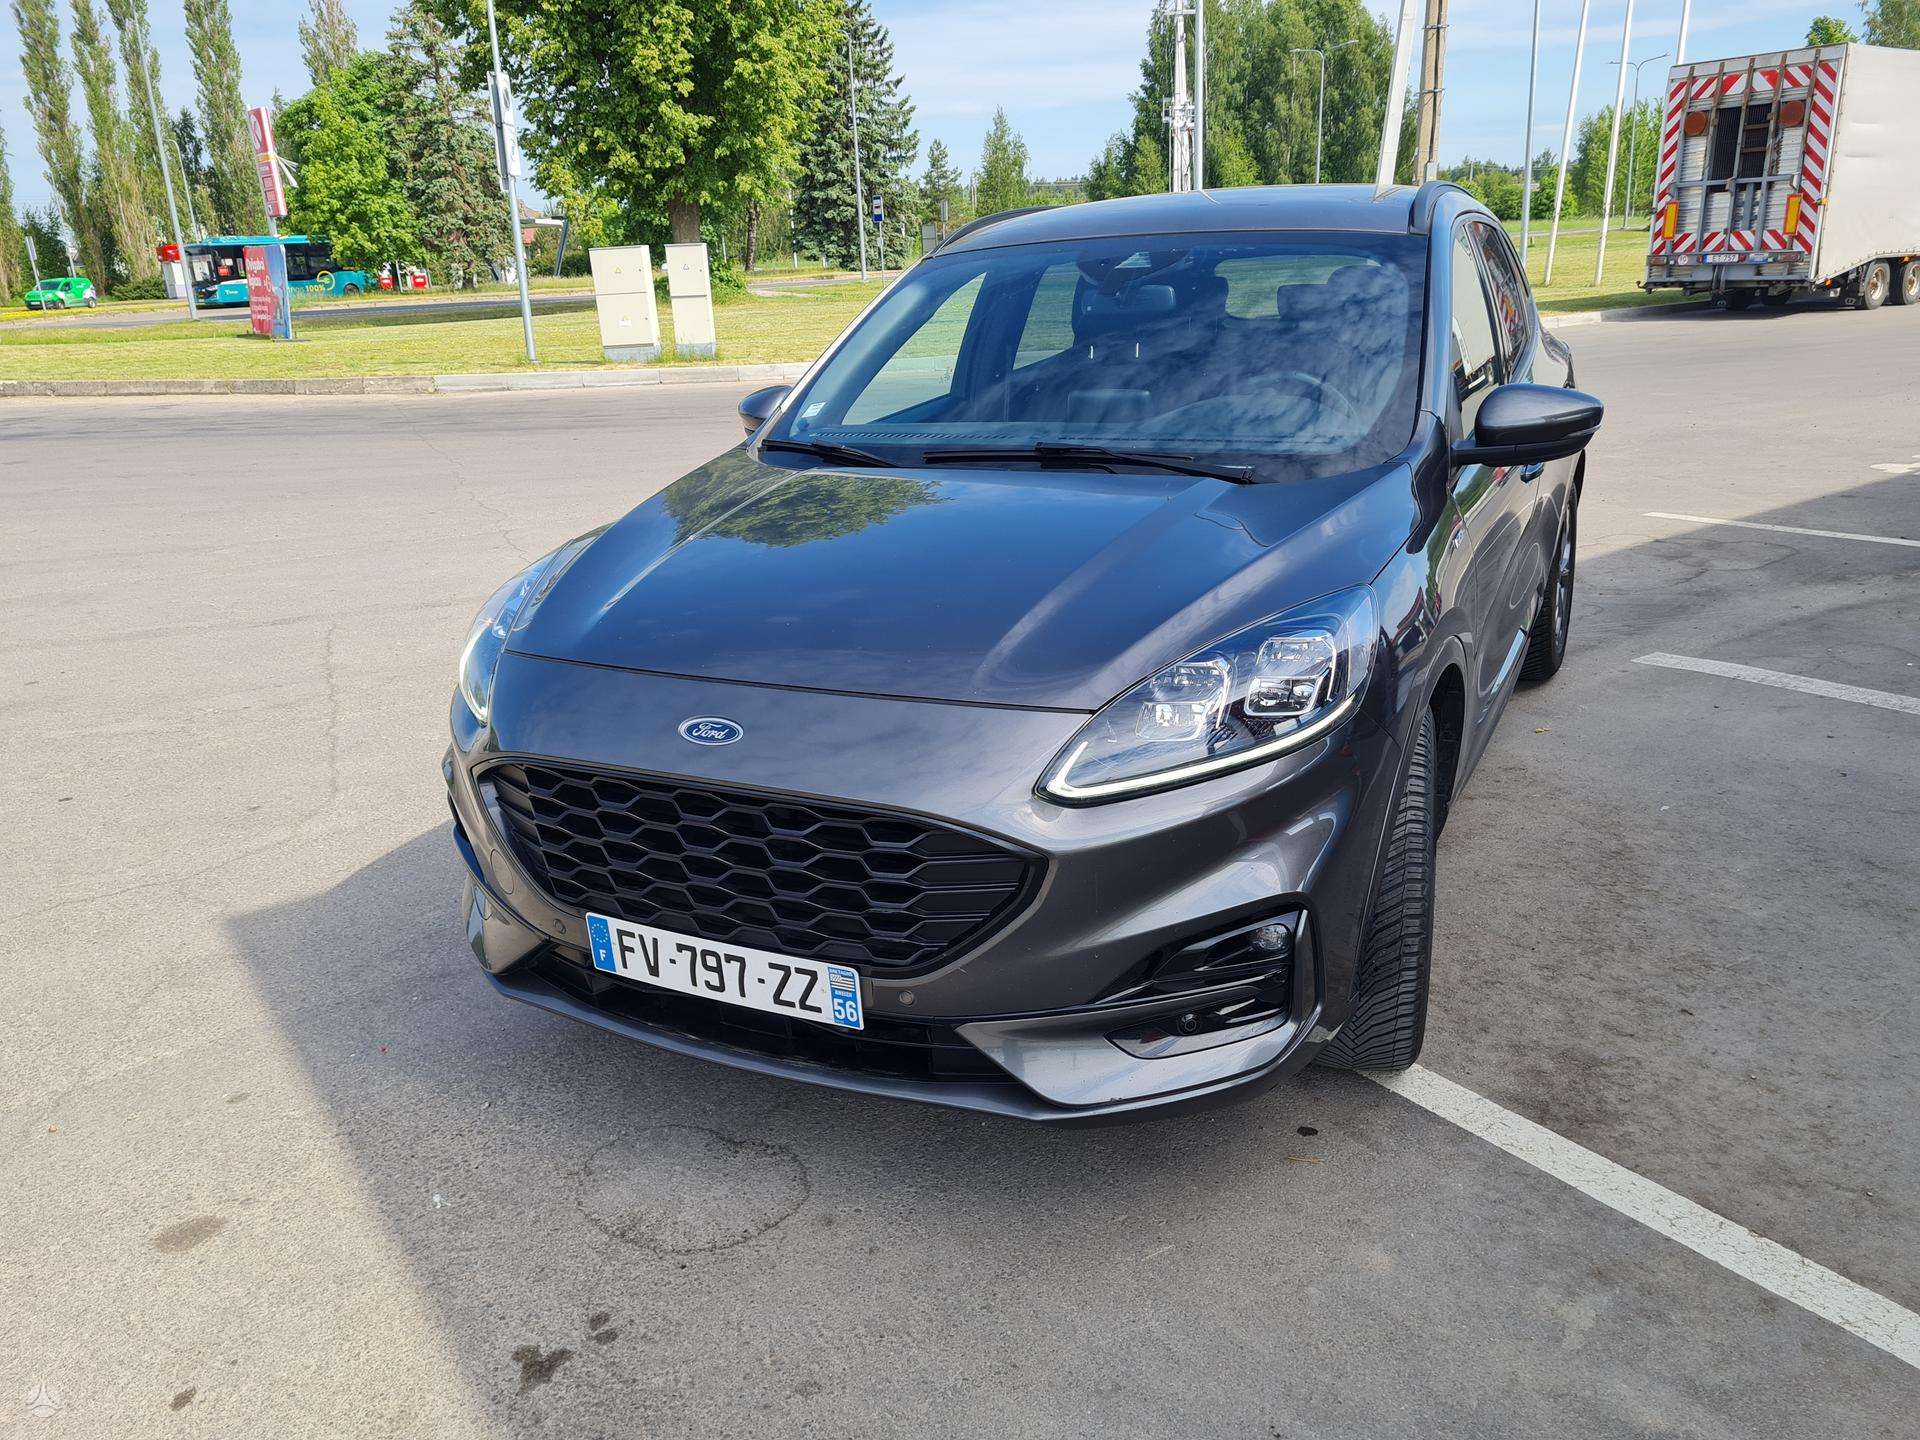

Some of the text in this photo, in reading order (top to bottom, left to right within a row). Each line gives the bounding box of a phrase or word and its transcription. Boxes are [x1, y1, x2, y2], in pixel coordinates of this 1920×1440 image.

[692, 722, 730, 740] Ford
[599, 948, 607, 961] F
[616, 928, 823, 1014] FV-797-ZZ
[833, 997, 858, 1022] 56
